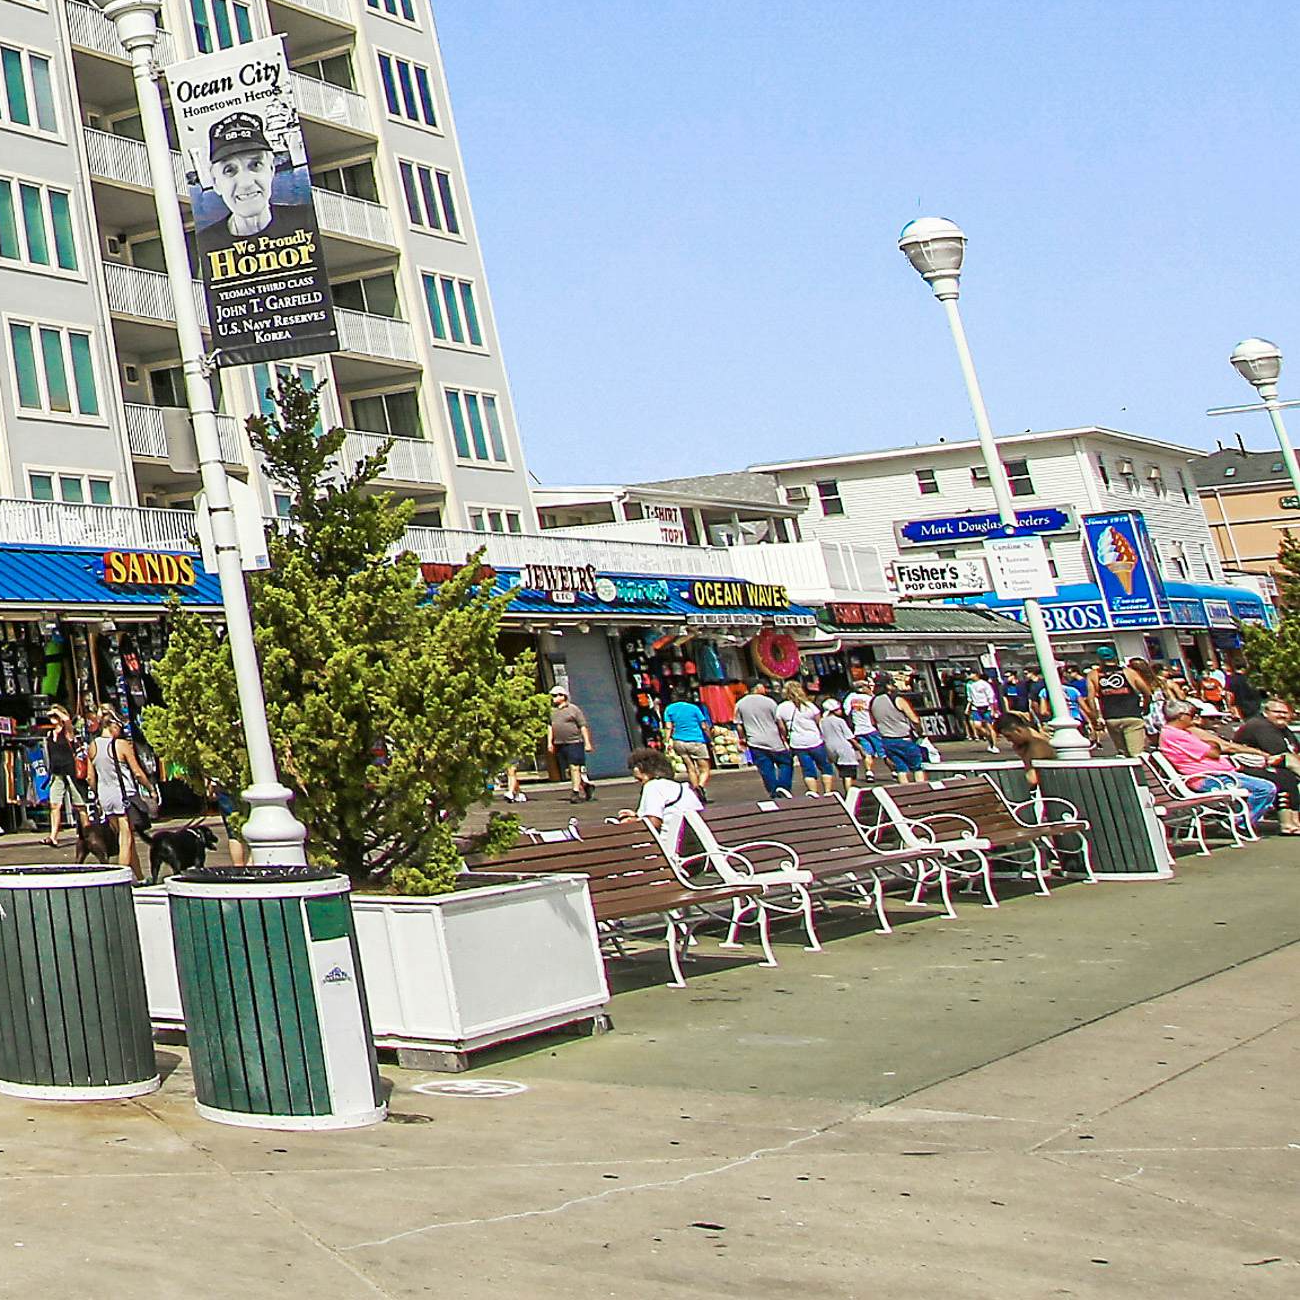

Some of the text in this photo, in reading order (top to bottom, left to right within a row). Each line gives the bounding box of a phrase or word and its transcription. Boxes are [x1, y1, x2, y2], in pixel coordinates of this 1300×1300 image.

[176, 61, 281, 103] Ocean City
[182, 97, 242, 119] Hometown
[232, 229, 314, 255] We Proudly
[207, 243, 316, 282] Honor
[218, 276, 315, 301] YEOMAN THIRD CLASS
[215, 292, 323, 323] JOHN T. GARFIELD
[218, 311, 326, 336] U.S. NAVY RESERVES
[254, 330, 292, 344] KOREA
[920, 523, 954, 536] Mark
[108, 551, 196, 586] SANDS
[524, 563, 597, 592] JEWELRY
[896, 561, 960, 583] Fisher's
[694, 581, 743, 607] OCEAN
[746, 583, 791, 608] WAVES
[904, 581, 958, 591] POP CORN
[1041, 605, 1107, 632] BROS.
